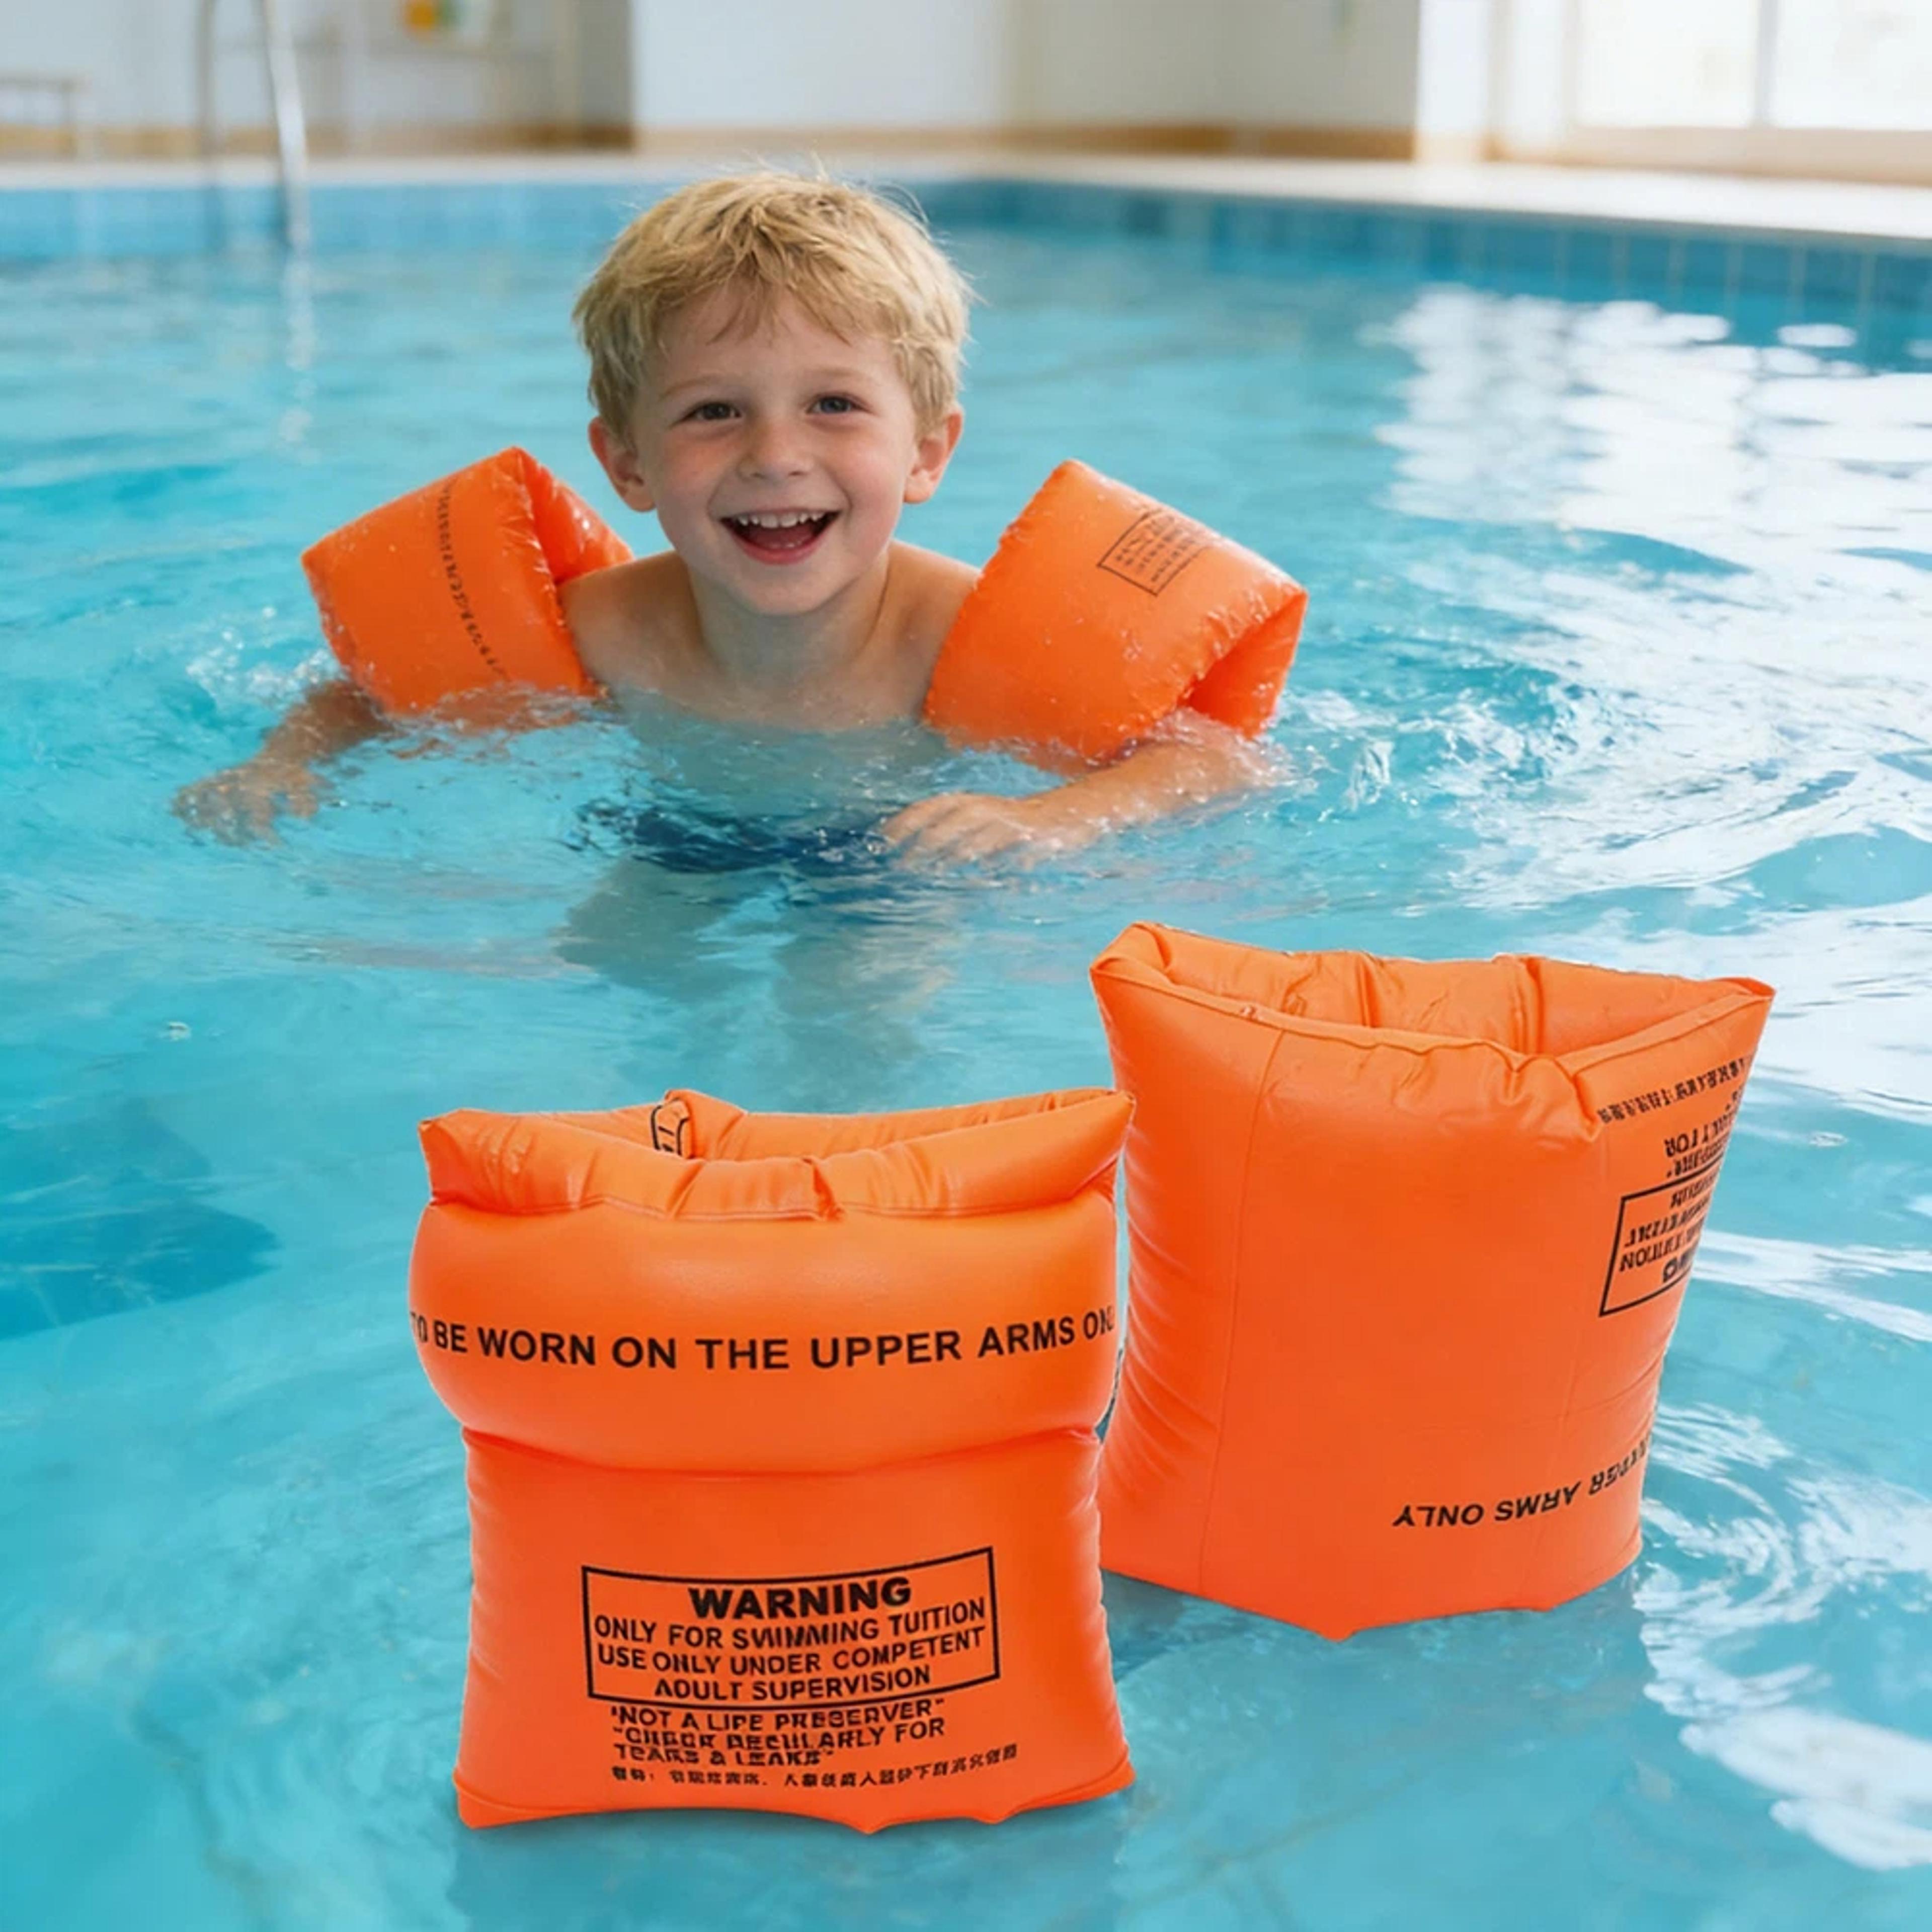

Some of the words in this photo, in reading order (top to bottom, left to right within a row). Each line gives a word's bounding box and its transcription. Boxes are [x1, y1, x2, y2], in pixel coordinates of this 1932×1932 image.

[434, 1319, 467, 1353] BE
[477, 1326, 596, 1366] WORN
[611, 1336, 676, 1370] ON
[695, 1338, 789, 1370] THE
[811, 1331, 961, 1369] UPPER
[977, 1317, 1075, 1358] ARMS
[1392, 1503, 1485, 1527] ONLY
[1494, 1482, 1581, 1521] ARMS
[688, 1577, 911, 1620] WARNING
[595, 1615, 656, 1643] ONLY
[669, 1624, 722, 1648] FOR
[888, 1597, 985, 1636] TUITION
[598, 1644, 647, 1669] USE
[653, 1651, 720, 1674] ONLY
[730, 1653, 821, 1675] UNDER
[833, 1626, 985, 1669] COMPETENT
[655, 1678, 743, 1700] ADULT
[752, 1665, 930, 1701] SUPERVISION
[681, 1712, 699, 1730] A
[895, 1717, 944, 1743] FOR
